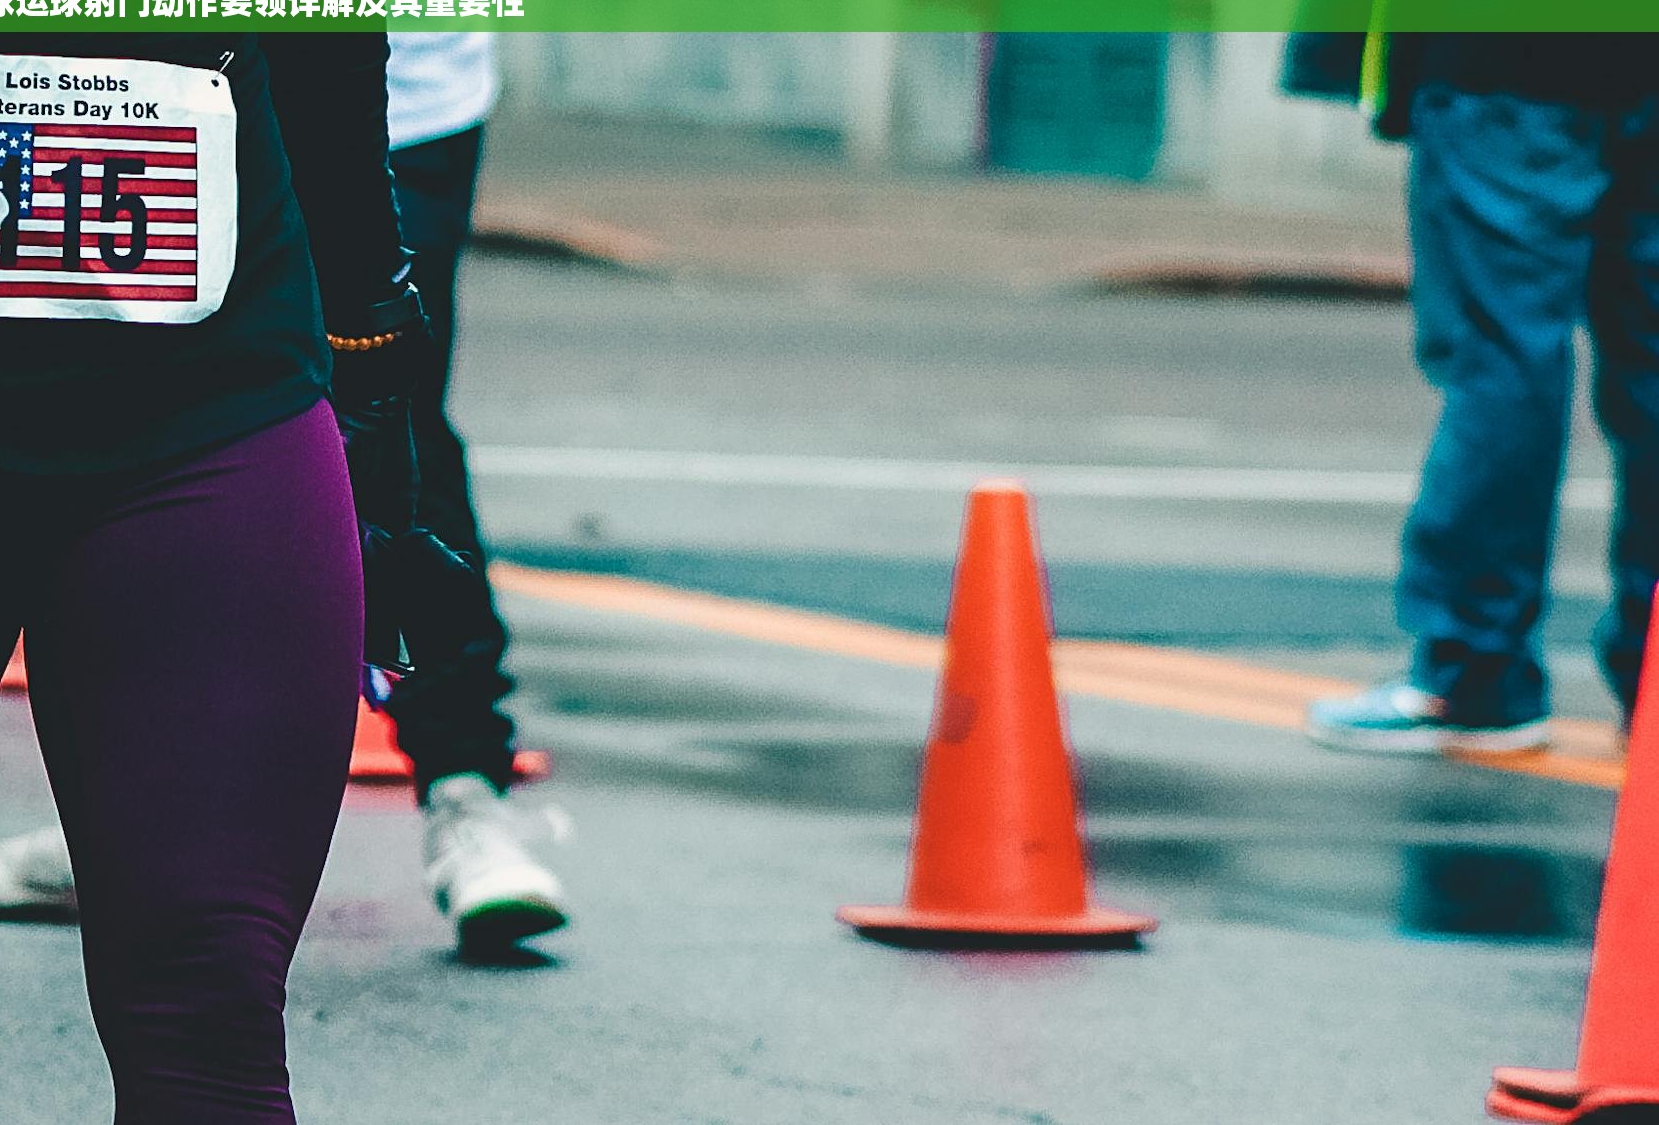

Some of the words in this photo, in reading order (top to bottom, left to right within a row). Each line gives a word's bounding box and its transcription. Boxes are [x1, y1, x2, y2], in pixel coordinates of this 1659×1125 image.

[5, 72, 51, 90] Lois
[57, 73, 129, 93] Stobbs
[73, 100, 113, 120] Day
[121, 102, 160, 119] 10K
